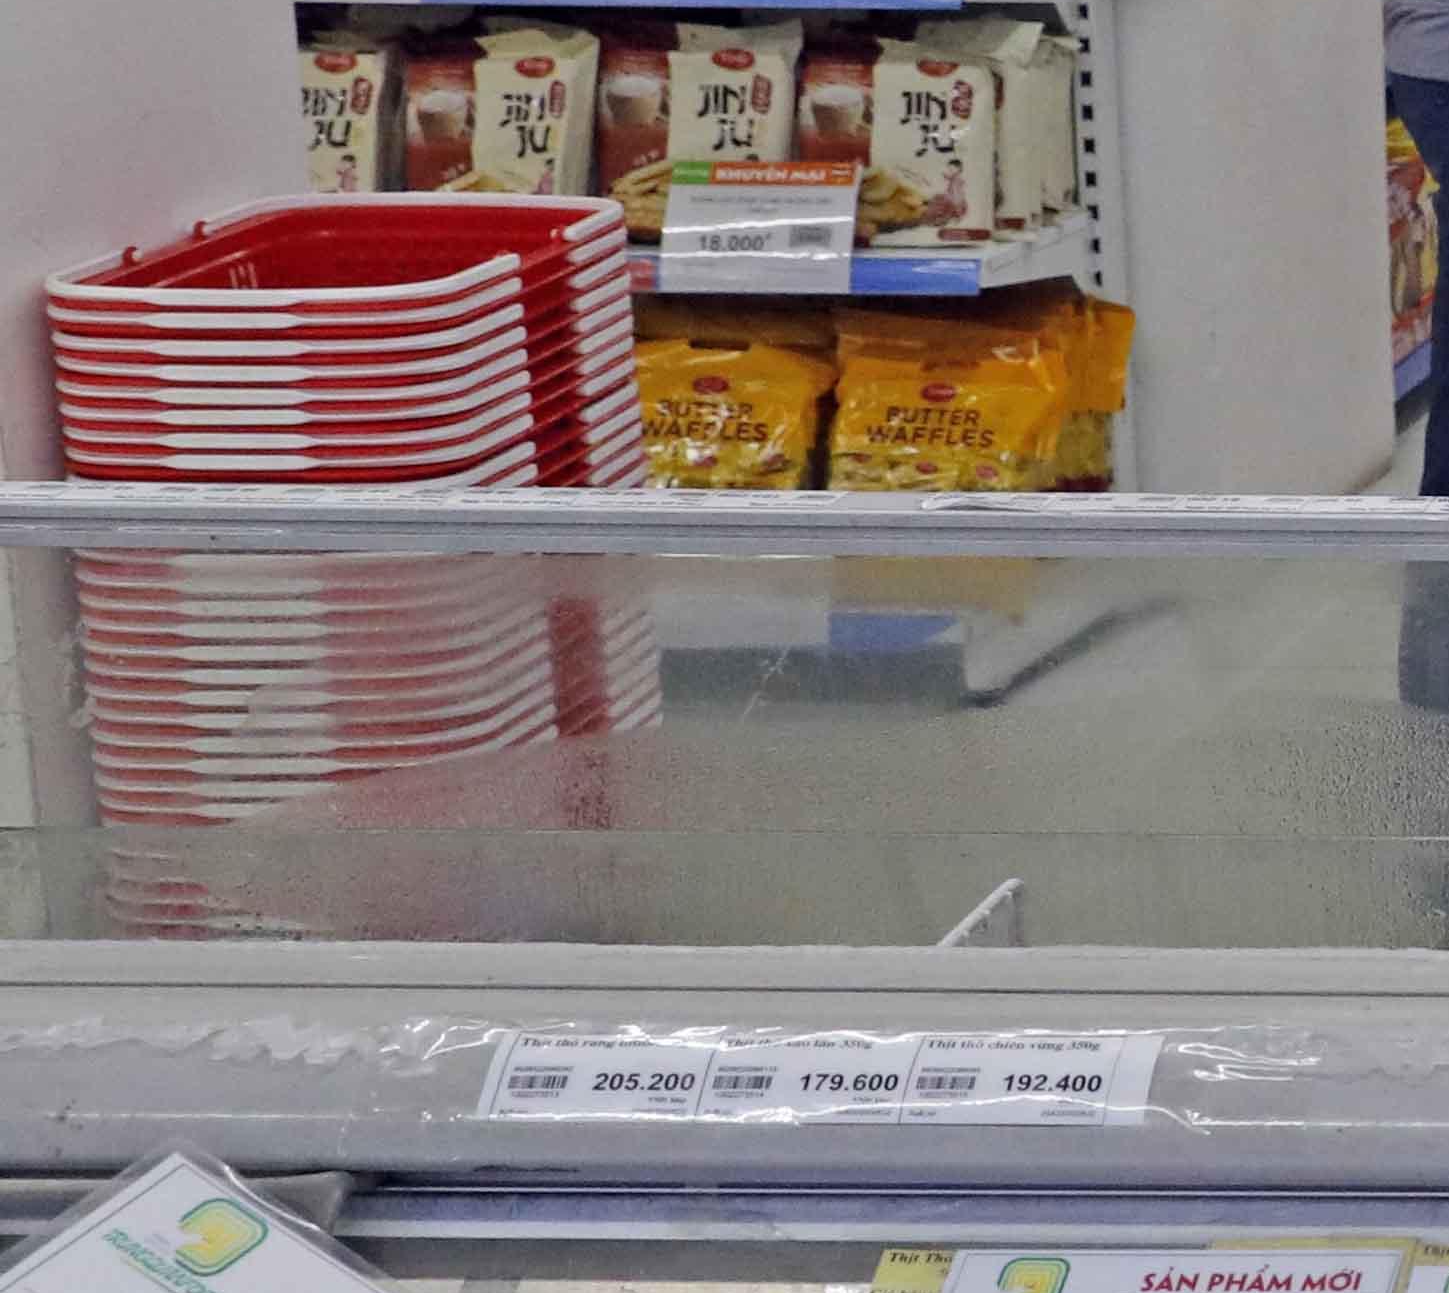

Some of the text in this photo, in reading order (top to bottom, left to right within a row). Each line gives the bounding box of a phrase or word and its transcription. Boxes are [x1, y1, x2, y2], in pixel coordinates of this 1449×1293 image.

[886, 407, 982, 426] BUTTER
[867, 427, 995, 449] WAFFLES
[592, 1072, 696, 1092] 205.200
[798, 1072, 899, 1092] 179.600
[1000, 1072, 1102, 1093] 192.400
[1139, 1263, 1362, 1293] SẢN PHẨM MỚI
